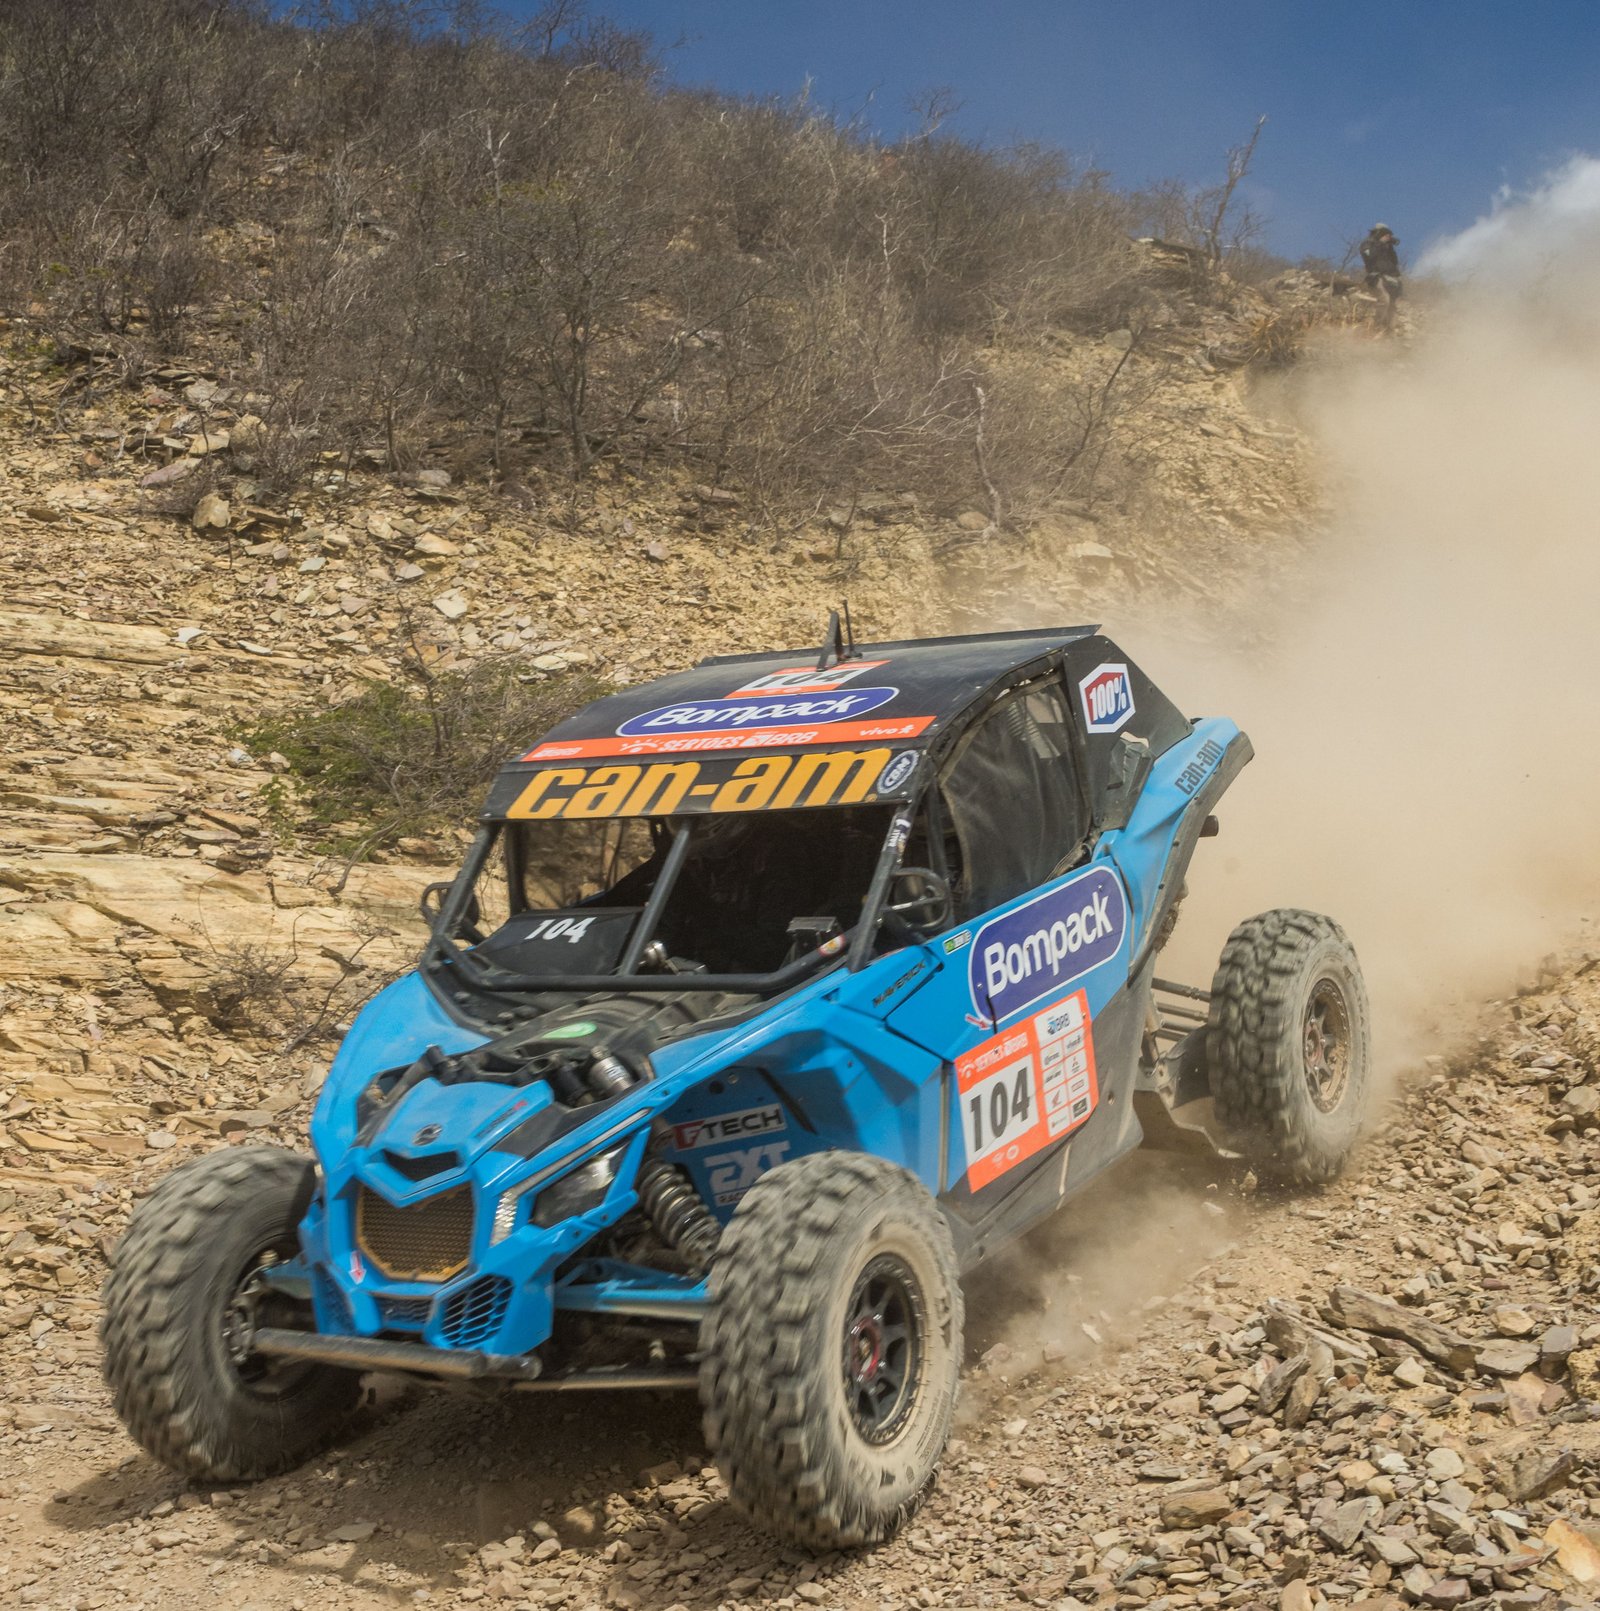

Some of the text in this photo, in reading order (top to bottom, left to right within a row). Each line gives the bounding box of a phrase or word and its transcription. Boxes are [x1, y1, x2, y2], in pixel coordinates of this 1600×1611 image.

[752, 669, 861, 688] 104
[643, 695, 870, 727] Bompack
[1090, 677, 1127, 721] 100%
[768, 731, 819, 745] BRB
[860, 727, 897, 736] vivo
[506, 748, 892, 818] can-am
[1174, 739, 1225, 796] can-am
[523, 916, 598, 944] 104
[984, 892, 1113, 999] Bompack
[969, 1067, 1030, 1153] 104
